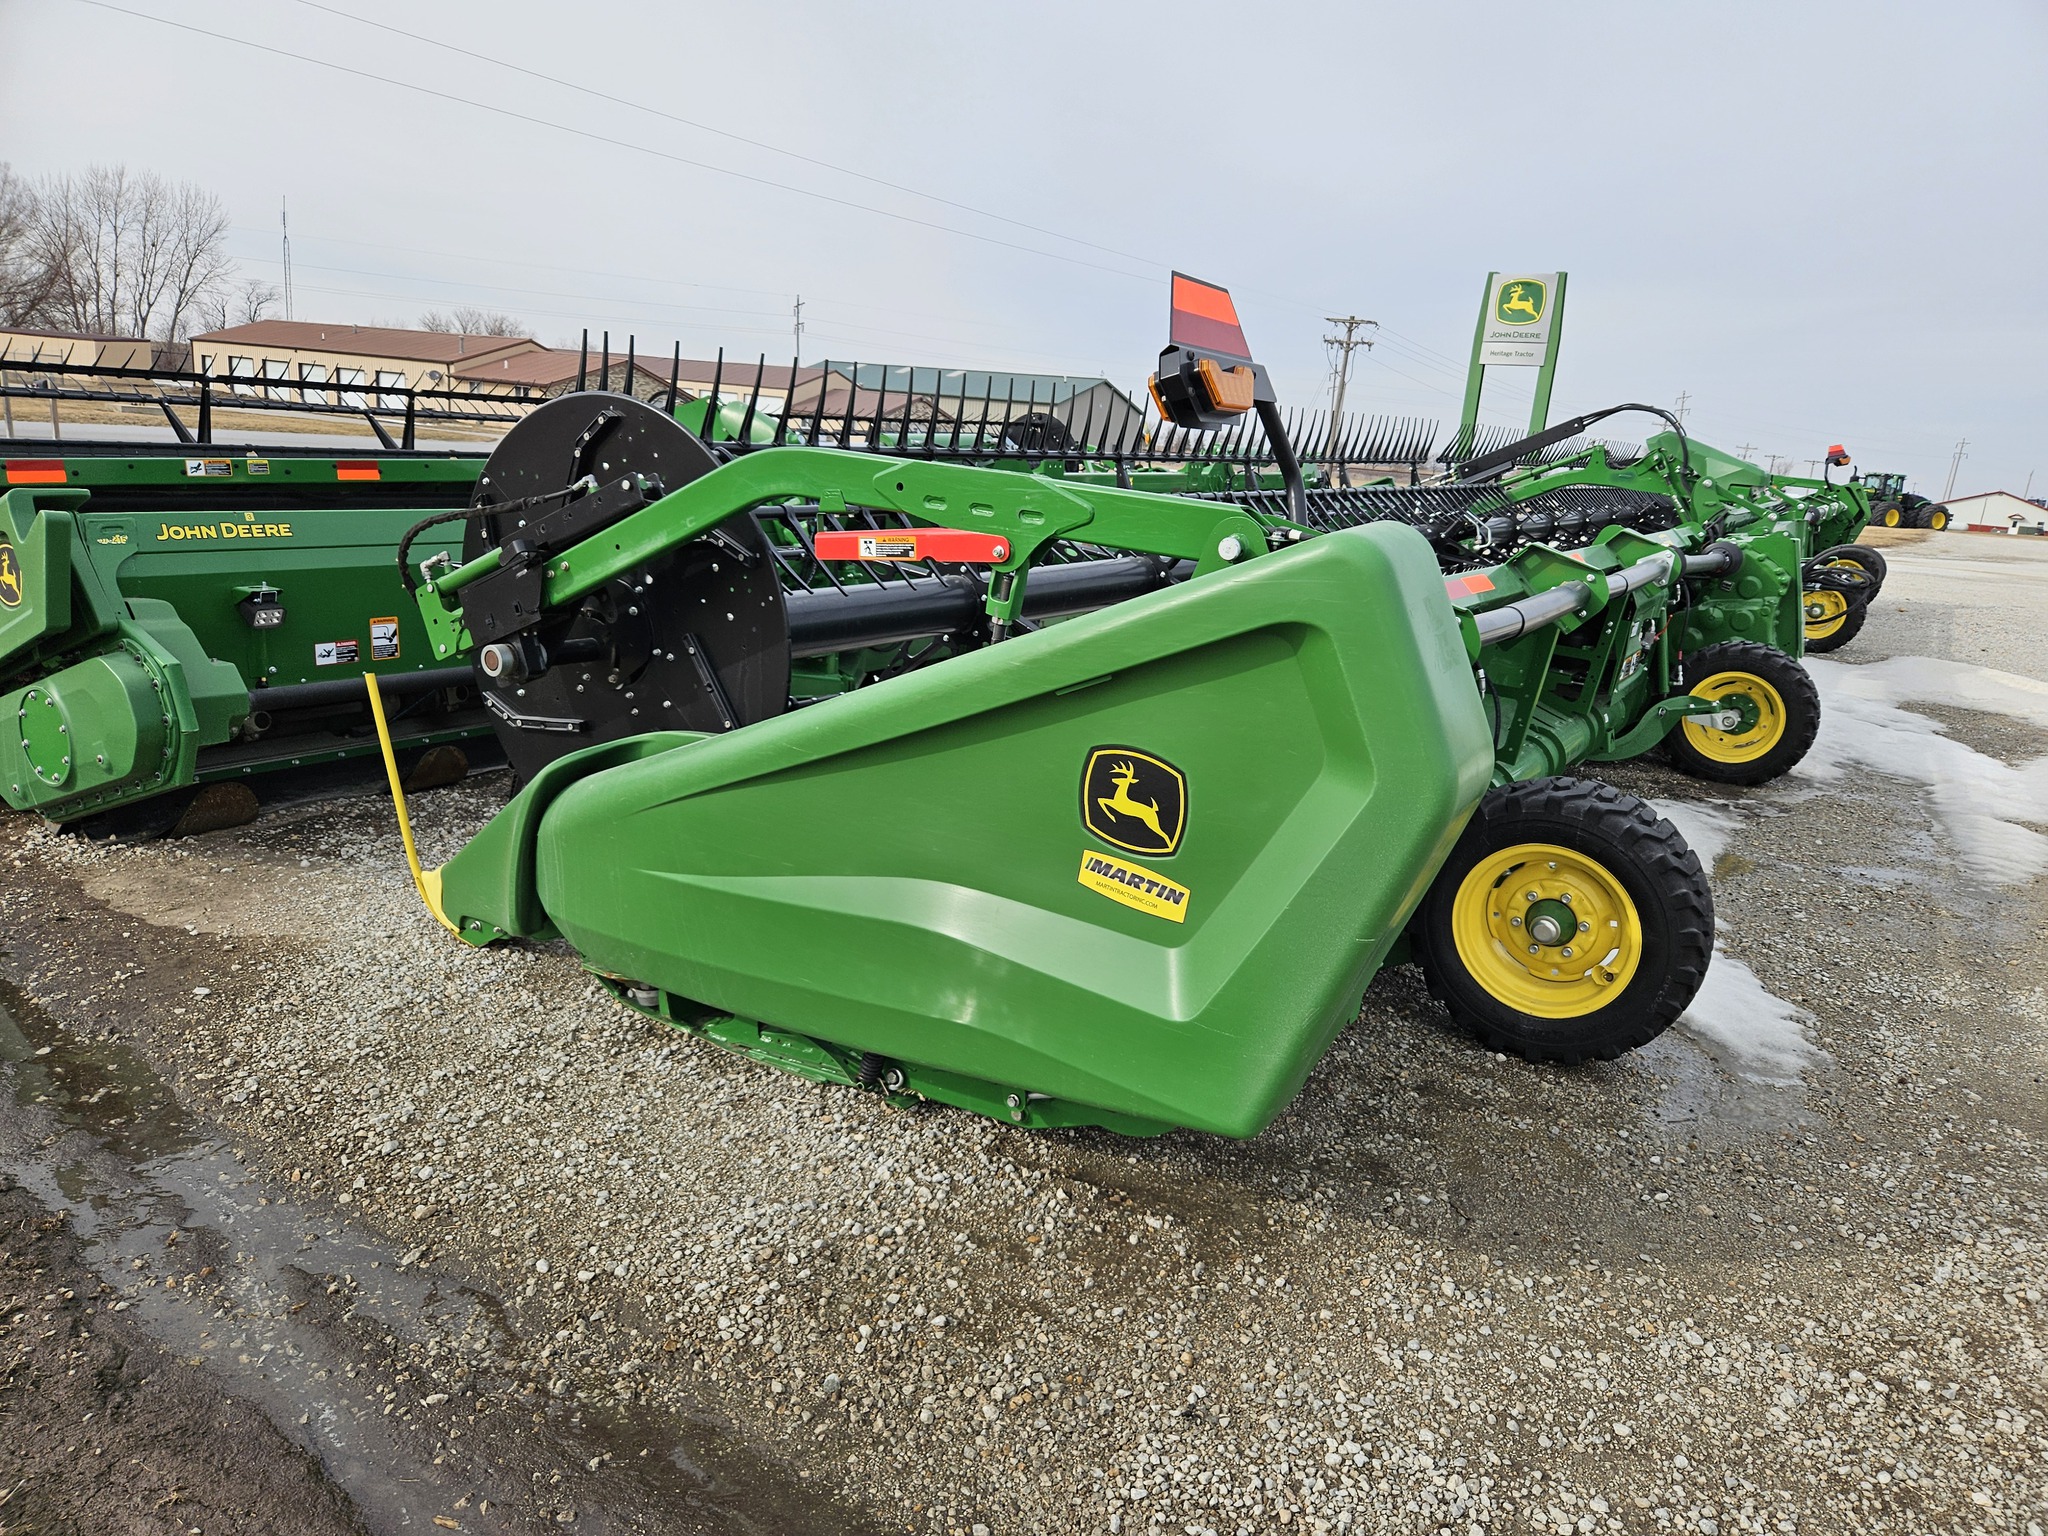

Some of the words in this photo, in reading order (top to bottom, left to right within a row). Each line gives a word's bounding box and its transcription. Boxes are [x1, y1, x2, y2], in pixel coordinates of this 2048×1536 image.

[1512, 331, 1541, 339] DEERE
[156, 523, 218, 541] JOHN
[219, 522, 293, 539] DEERE
[1089, 858, 1185, 906] MARTIN
